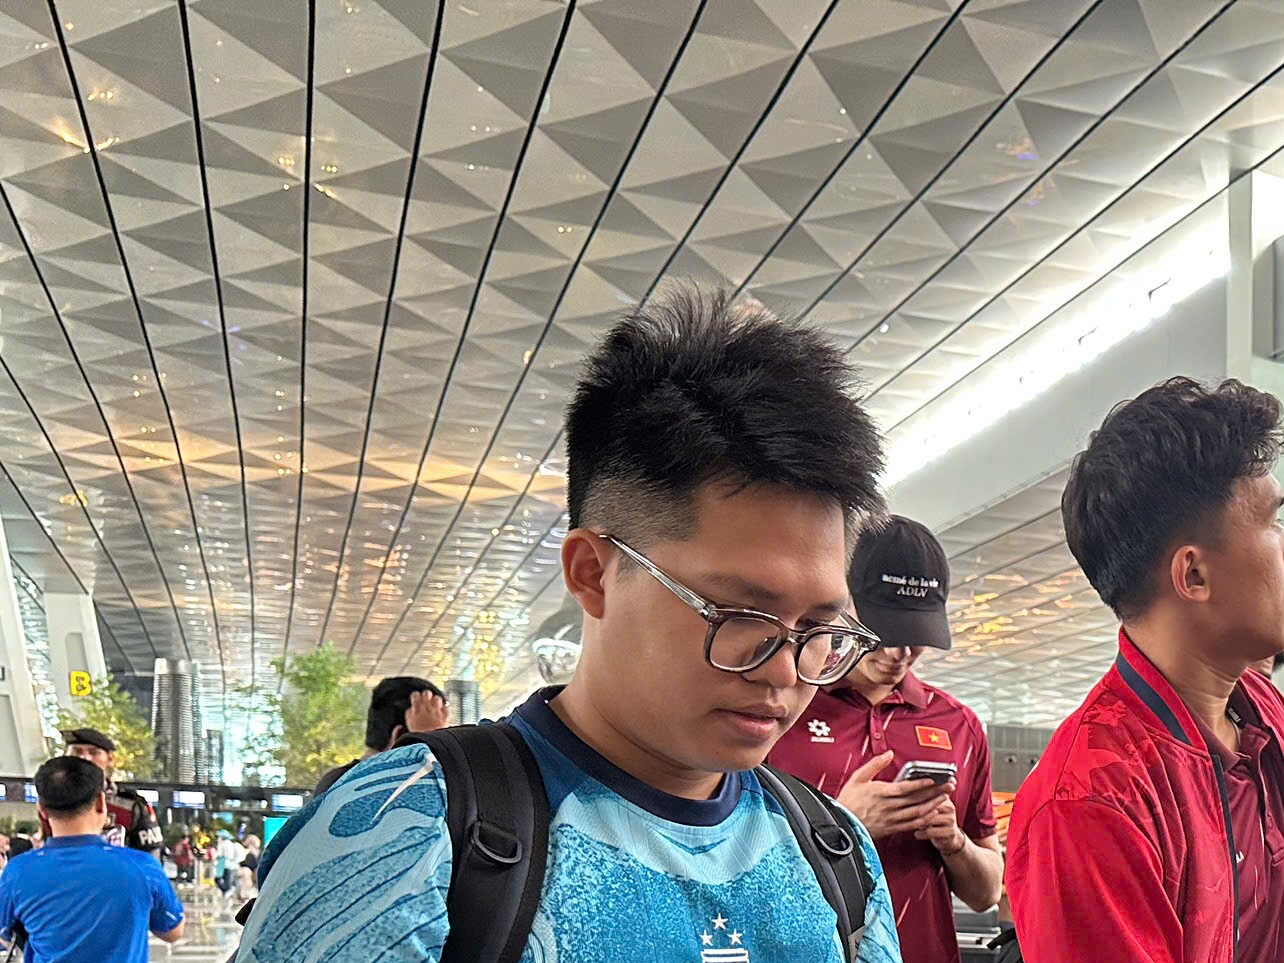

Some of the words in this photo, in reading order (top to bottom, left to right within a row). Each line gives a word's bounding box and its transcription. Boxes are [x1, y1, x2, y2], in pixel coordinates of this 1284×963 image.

[882, 574, 907, 585] acmé
[908, 577, 919, 587] de
[920, 578, 929, 587] la
[929, 579, 939, 588] vie
[897, 586, 928, 598] ADLV
[70, 670, 92, 697] B
